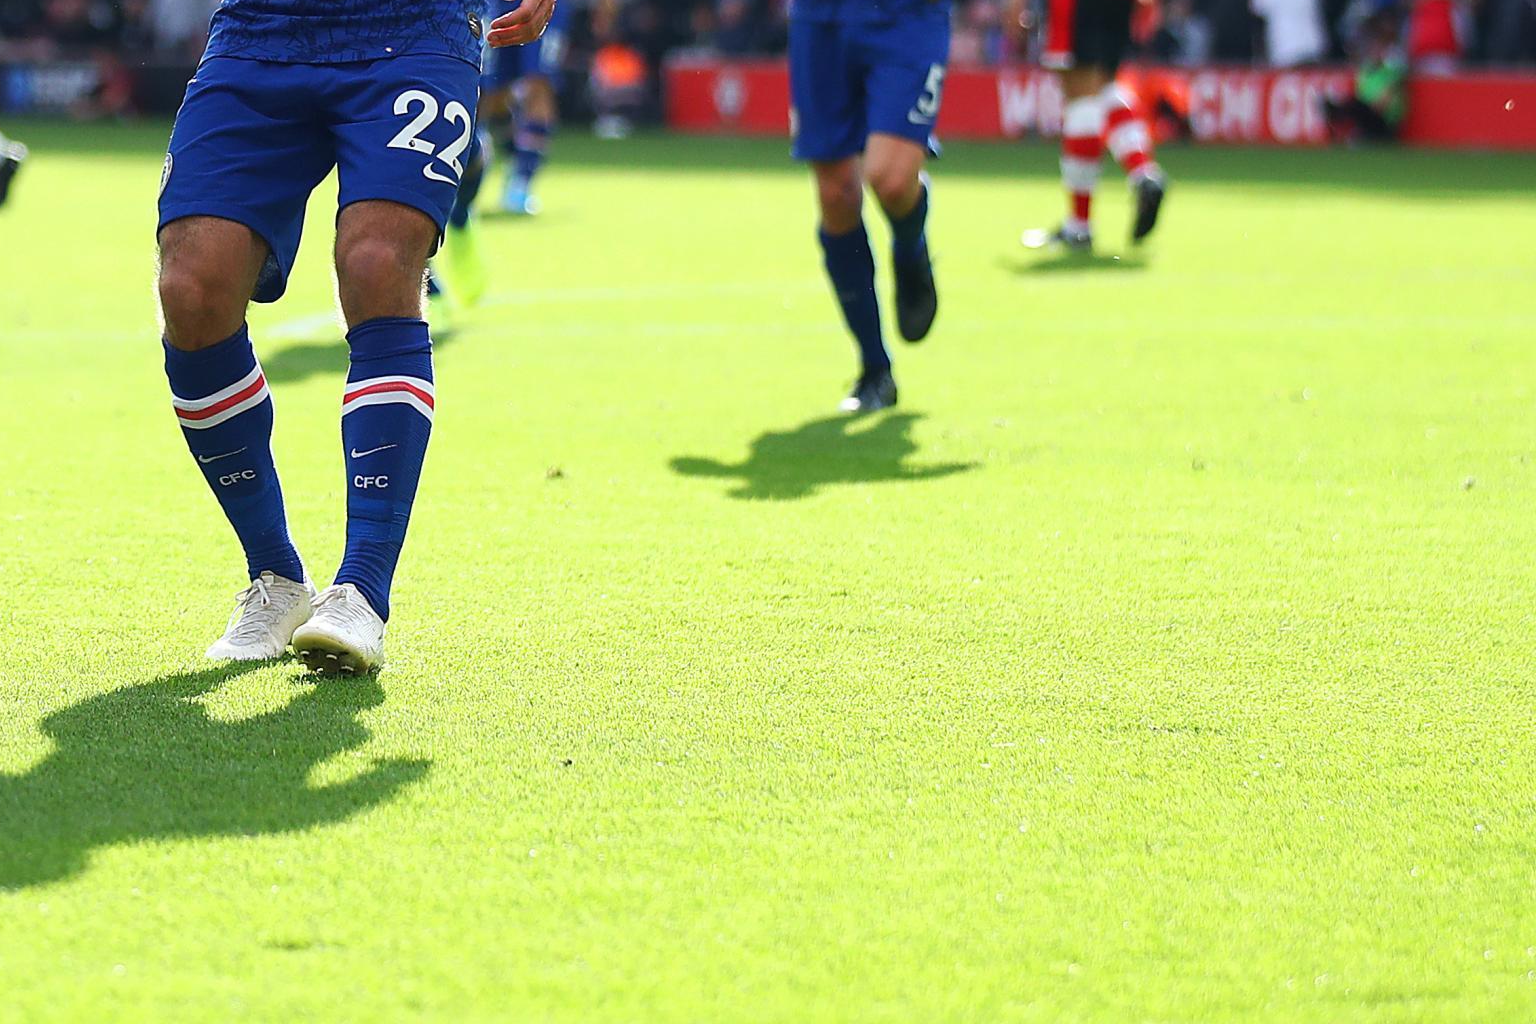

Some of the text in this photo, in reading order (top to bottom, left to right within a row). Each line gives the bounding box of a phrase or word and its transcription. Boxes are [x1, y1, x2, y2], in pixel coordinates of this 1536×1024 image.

[917, 62, 945, 117] 5
[386, 89, 472, 181] 22
[219, 469, 257, 486] CFC
[353, 475, 389, 489] CFC
